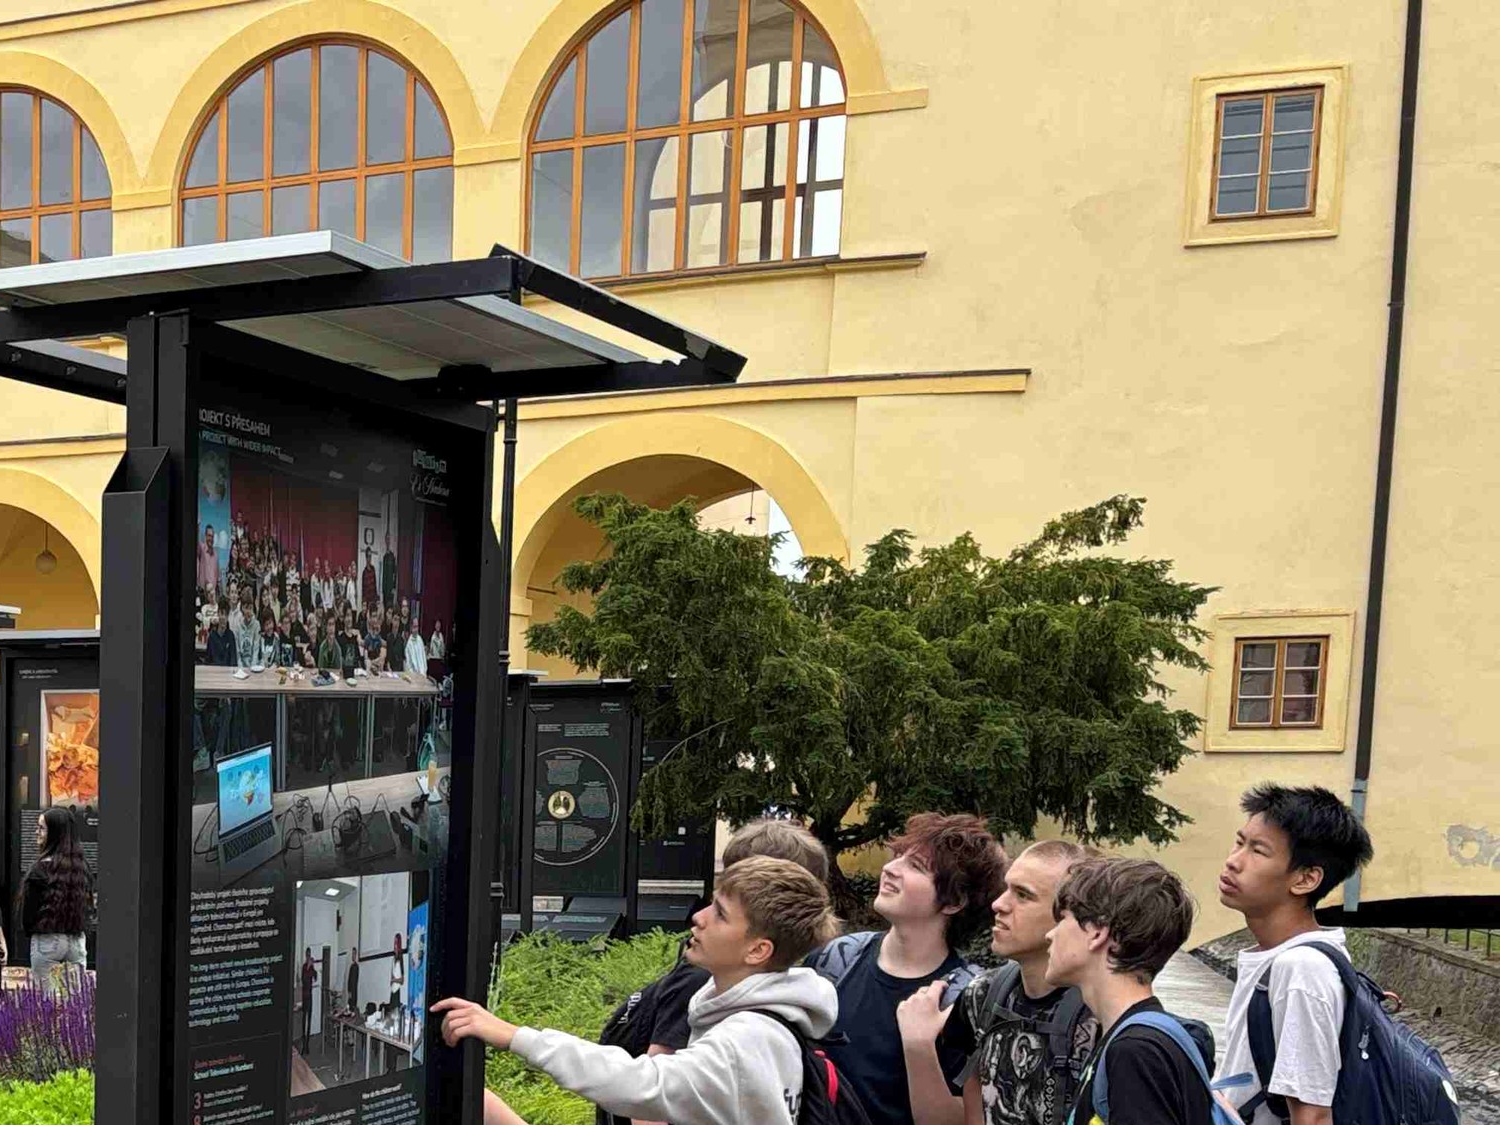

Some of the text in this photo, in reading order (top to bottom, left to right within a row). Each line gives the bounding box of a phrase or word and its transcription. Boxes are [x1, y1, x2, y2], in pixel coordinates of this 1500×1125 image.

[199, 408, 270, 437] OJEKT S PŘESAHEM
[227, 434, 242, 447] WITH
[194, 1092, 202, 1110] 3
